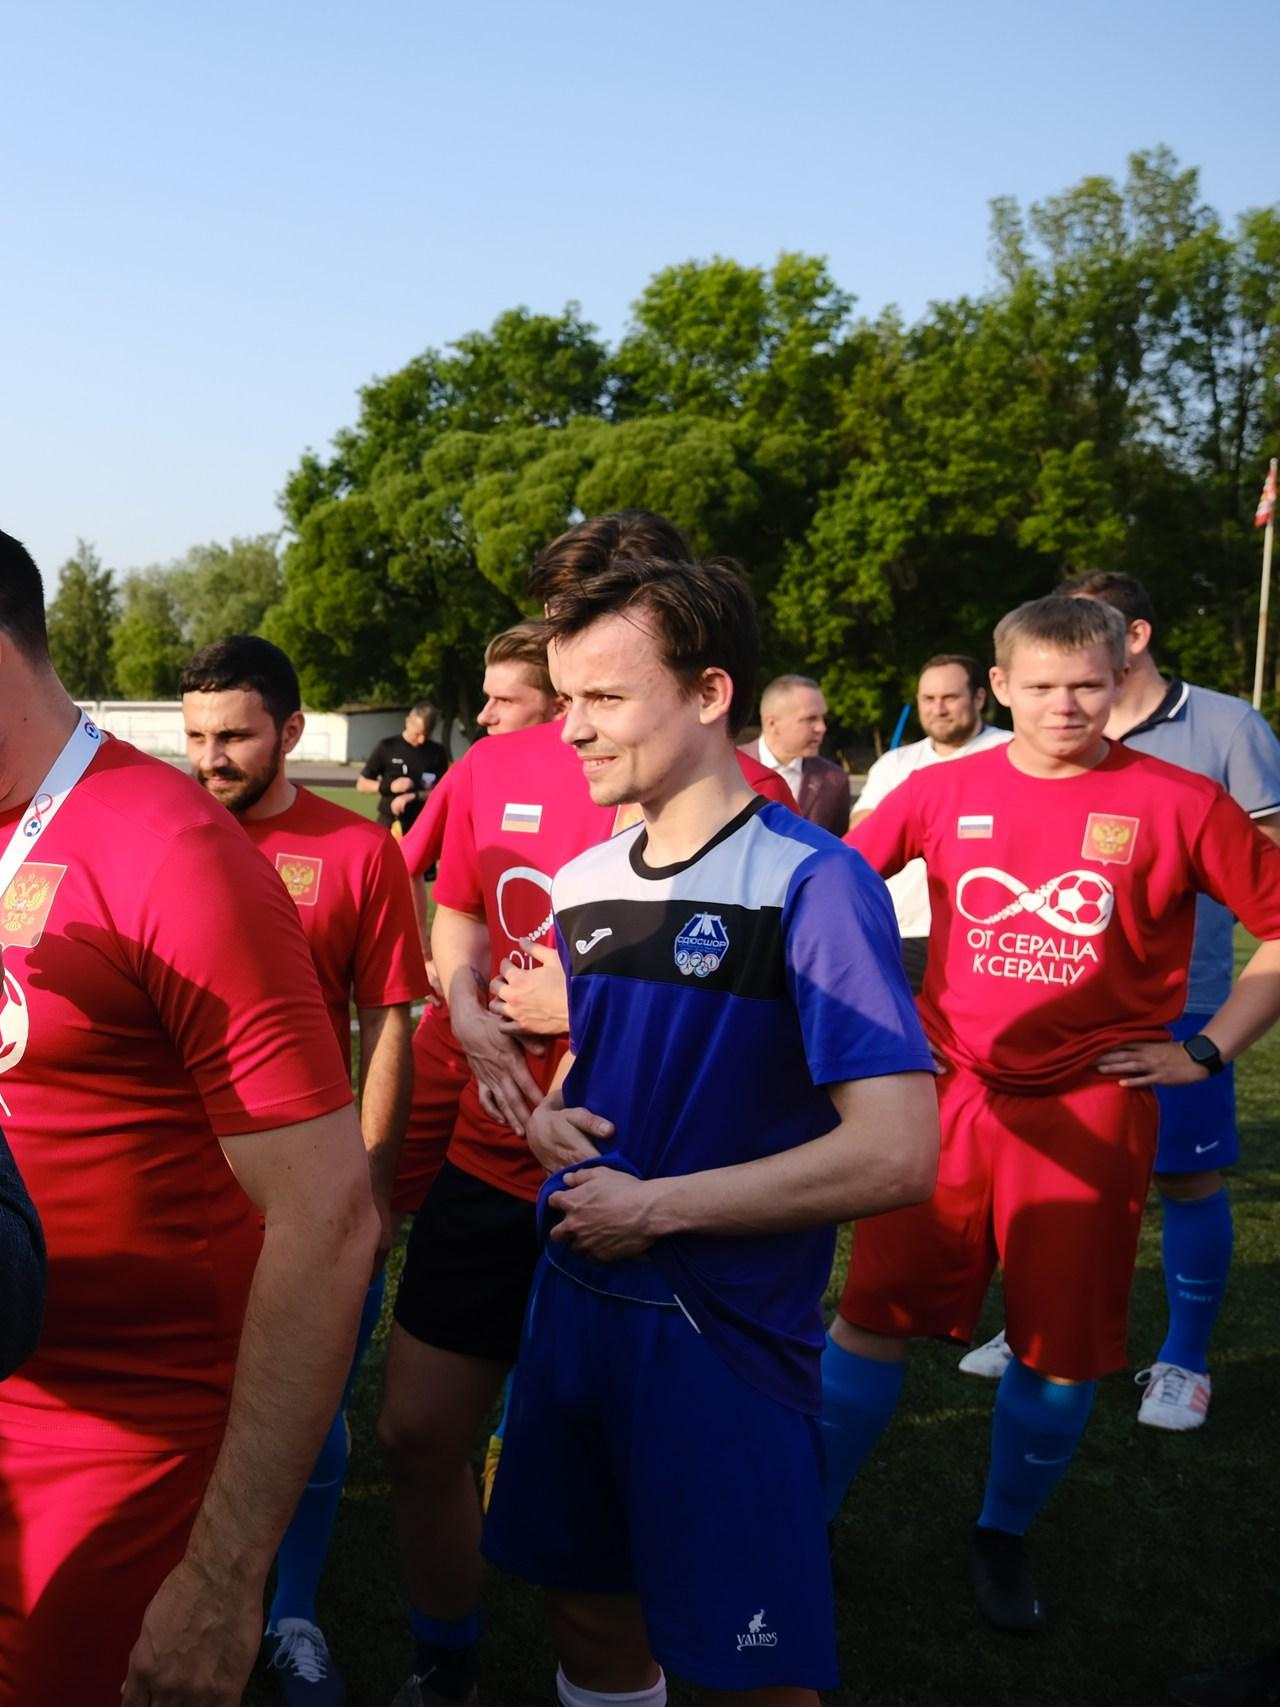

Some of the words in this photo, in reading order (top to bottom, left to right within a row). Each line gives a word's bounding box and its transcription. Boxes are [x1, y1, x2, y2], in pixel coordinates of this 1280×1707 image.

[677, 936, 727, 948] СДЮСШОР
[967, 928, 995, 950] ОТ
[998, 932, 1099, 963] СЕРДЦА
[972, 953, 986, 974] К
[987, 956, 1086, 987] СЕРДЦУ
